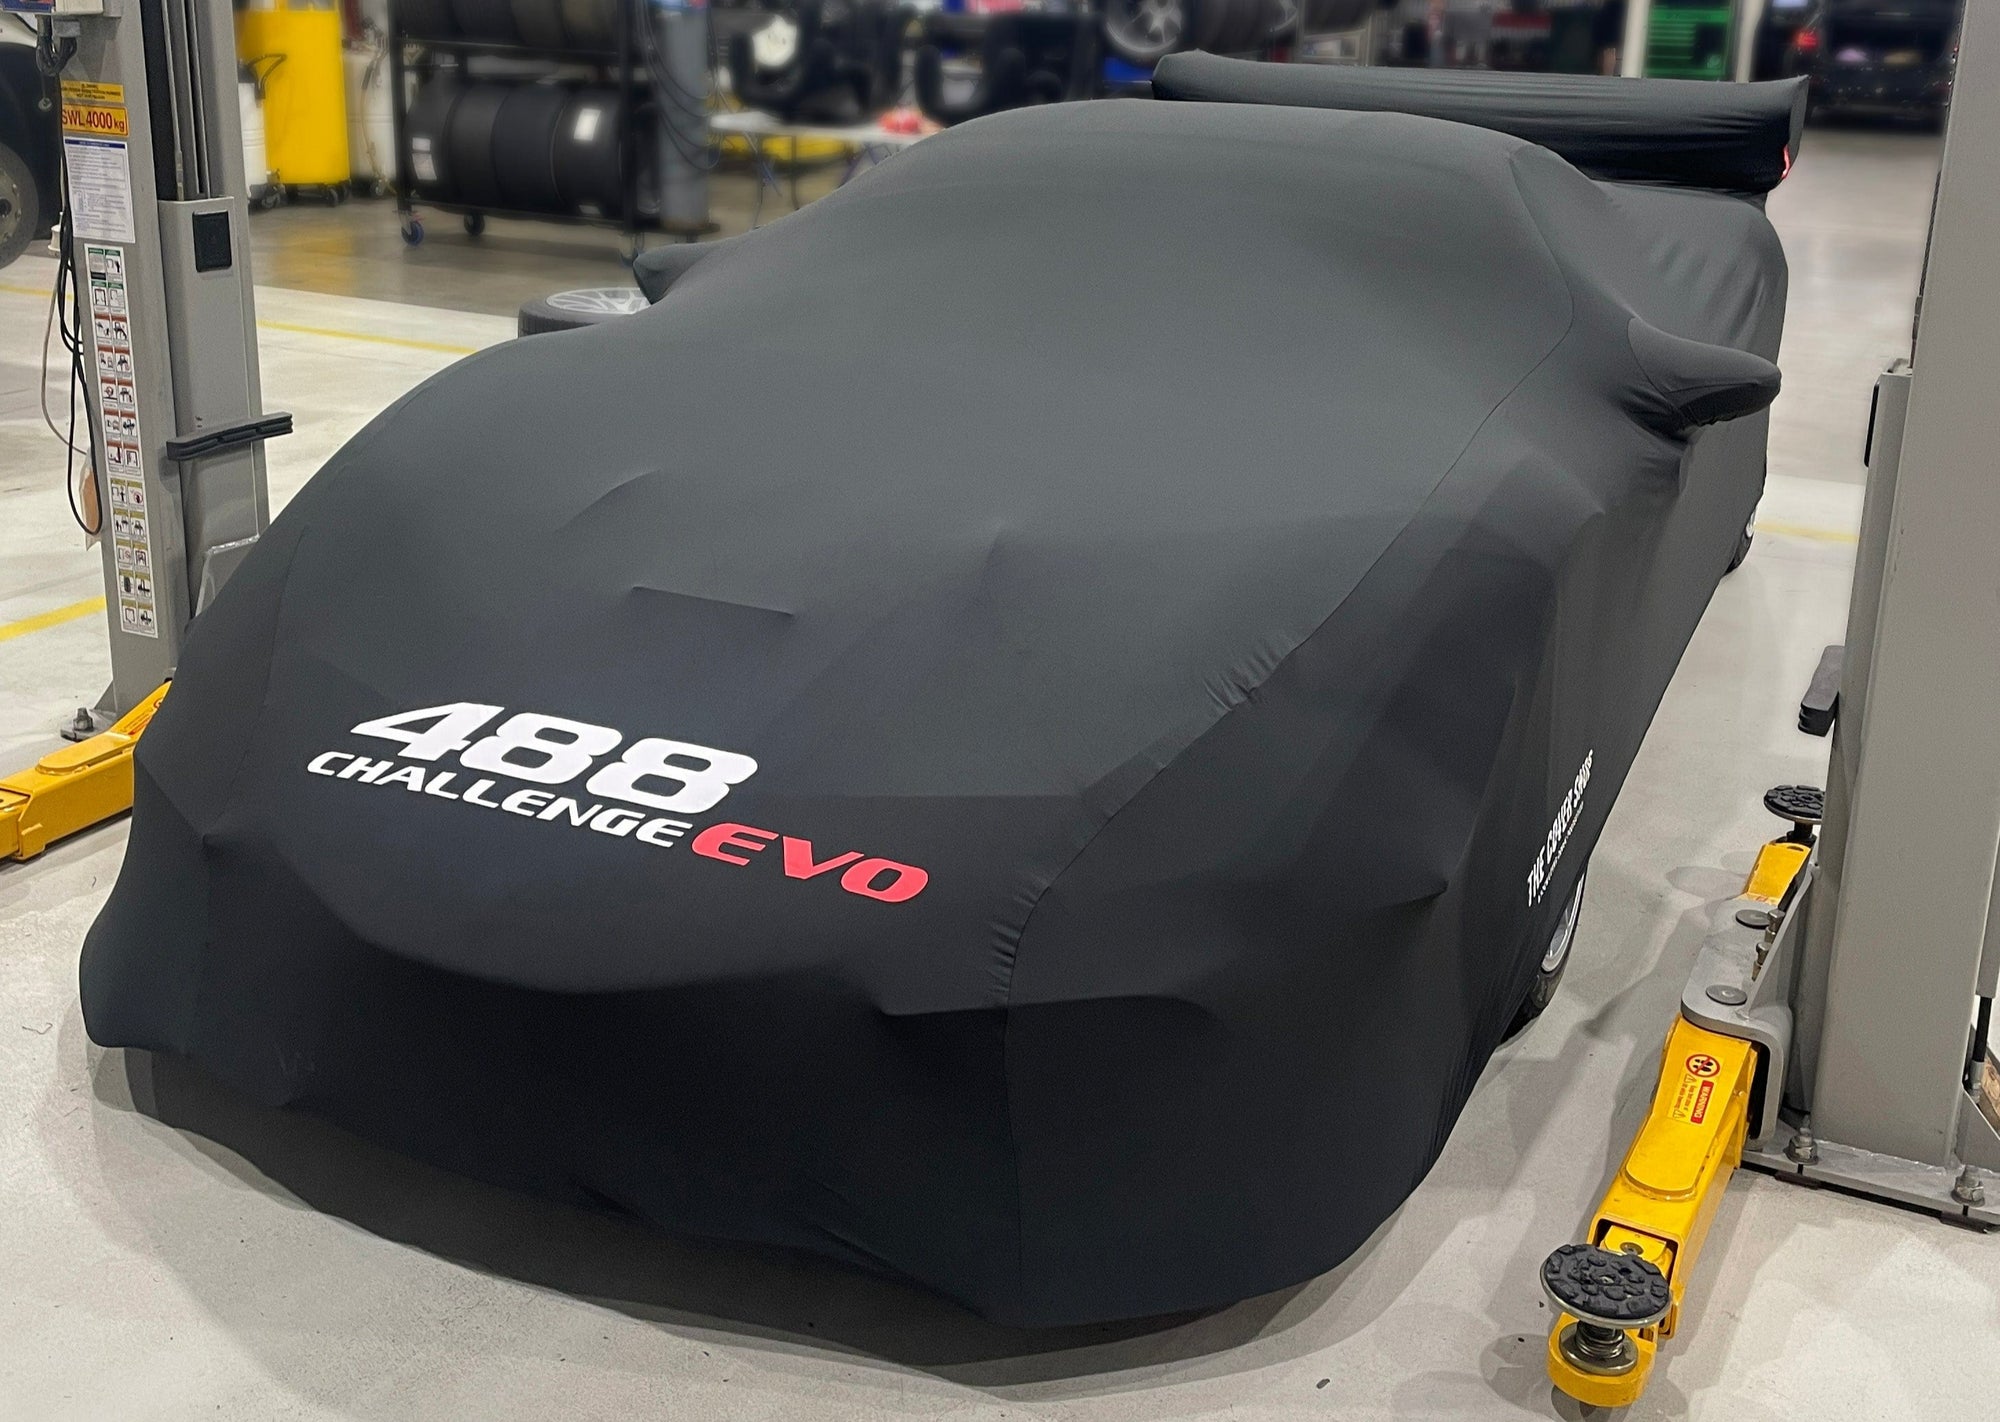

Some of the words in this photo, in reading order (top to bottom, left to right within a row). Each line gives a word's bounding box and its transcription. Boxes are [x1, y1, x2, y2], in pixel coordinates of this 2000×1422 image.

[62, 109, 85, 126] SWL
[86, 111, 113, 129] 4000
[114, 118, 124, 132] kg
[350, 701, 759, 814] 488
[307, 751, 693, 848] CHALLENGE
[691, 822, 929, 903] EVO
[1528, 845, 1545, 907] THE
